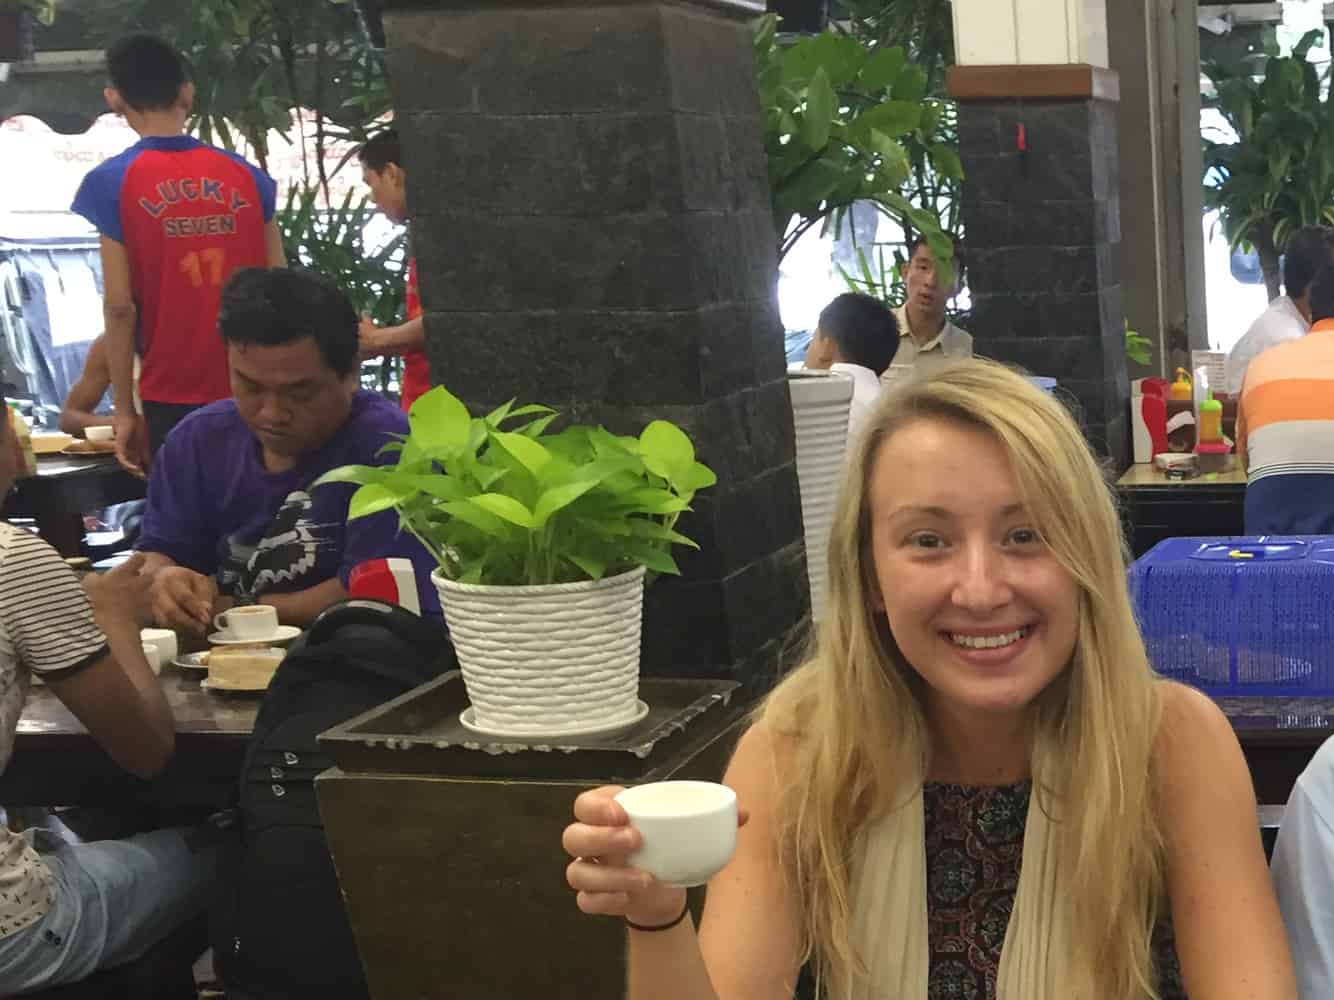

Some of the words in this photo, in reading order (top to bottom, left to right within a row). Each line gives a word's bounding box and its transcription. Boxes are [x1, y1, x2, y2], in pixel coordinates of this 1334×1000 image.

[138, 177, 252, 218] LUCKY
[163, 214, 237, 237] SEVEN
[180, 249, 225, 289] 17
